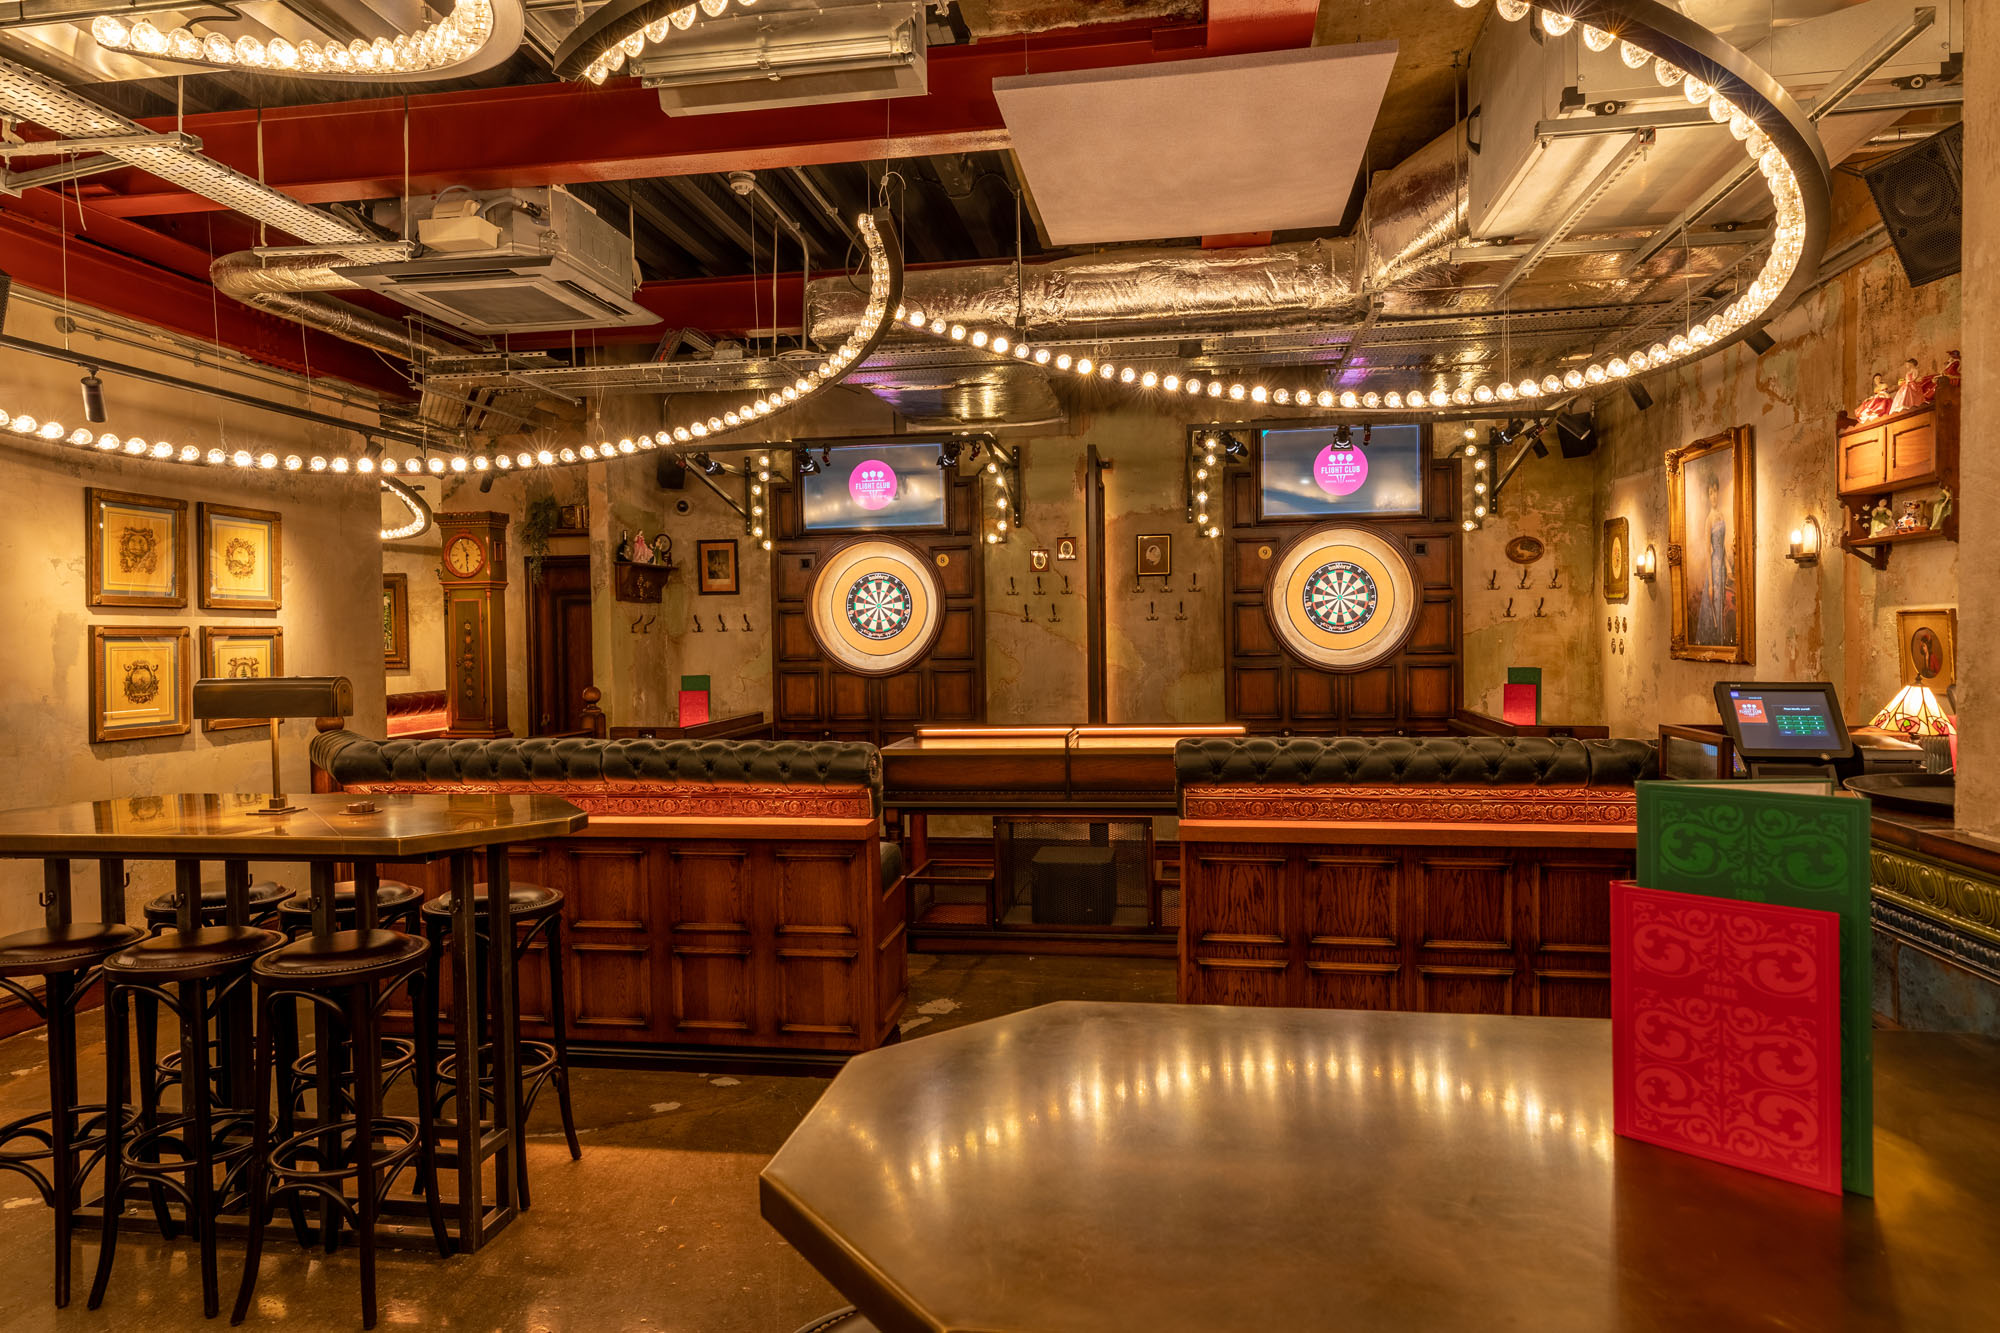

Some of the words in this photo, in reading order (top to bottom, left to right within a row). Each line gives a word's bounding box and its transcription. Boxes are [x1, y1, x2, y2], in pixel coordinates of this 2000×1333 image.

[1321, 466, 1343, 474] FLIGHT
[1344, 465, 1360, 473] CLUB
[855, 482, 875, 490] FLIGHT
[876, 481, 891, 489] CLUB
[1703, 983, 1738, 1001] DRINK
